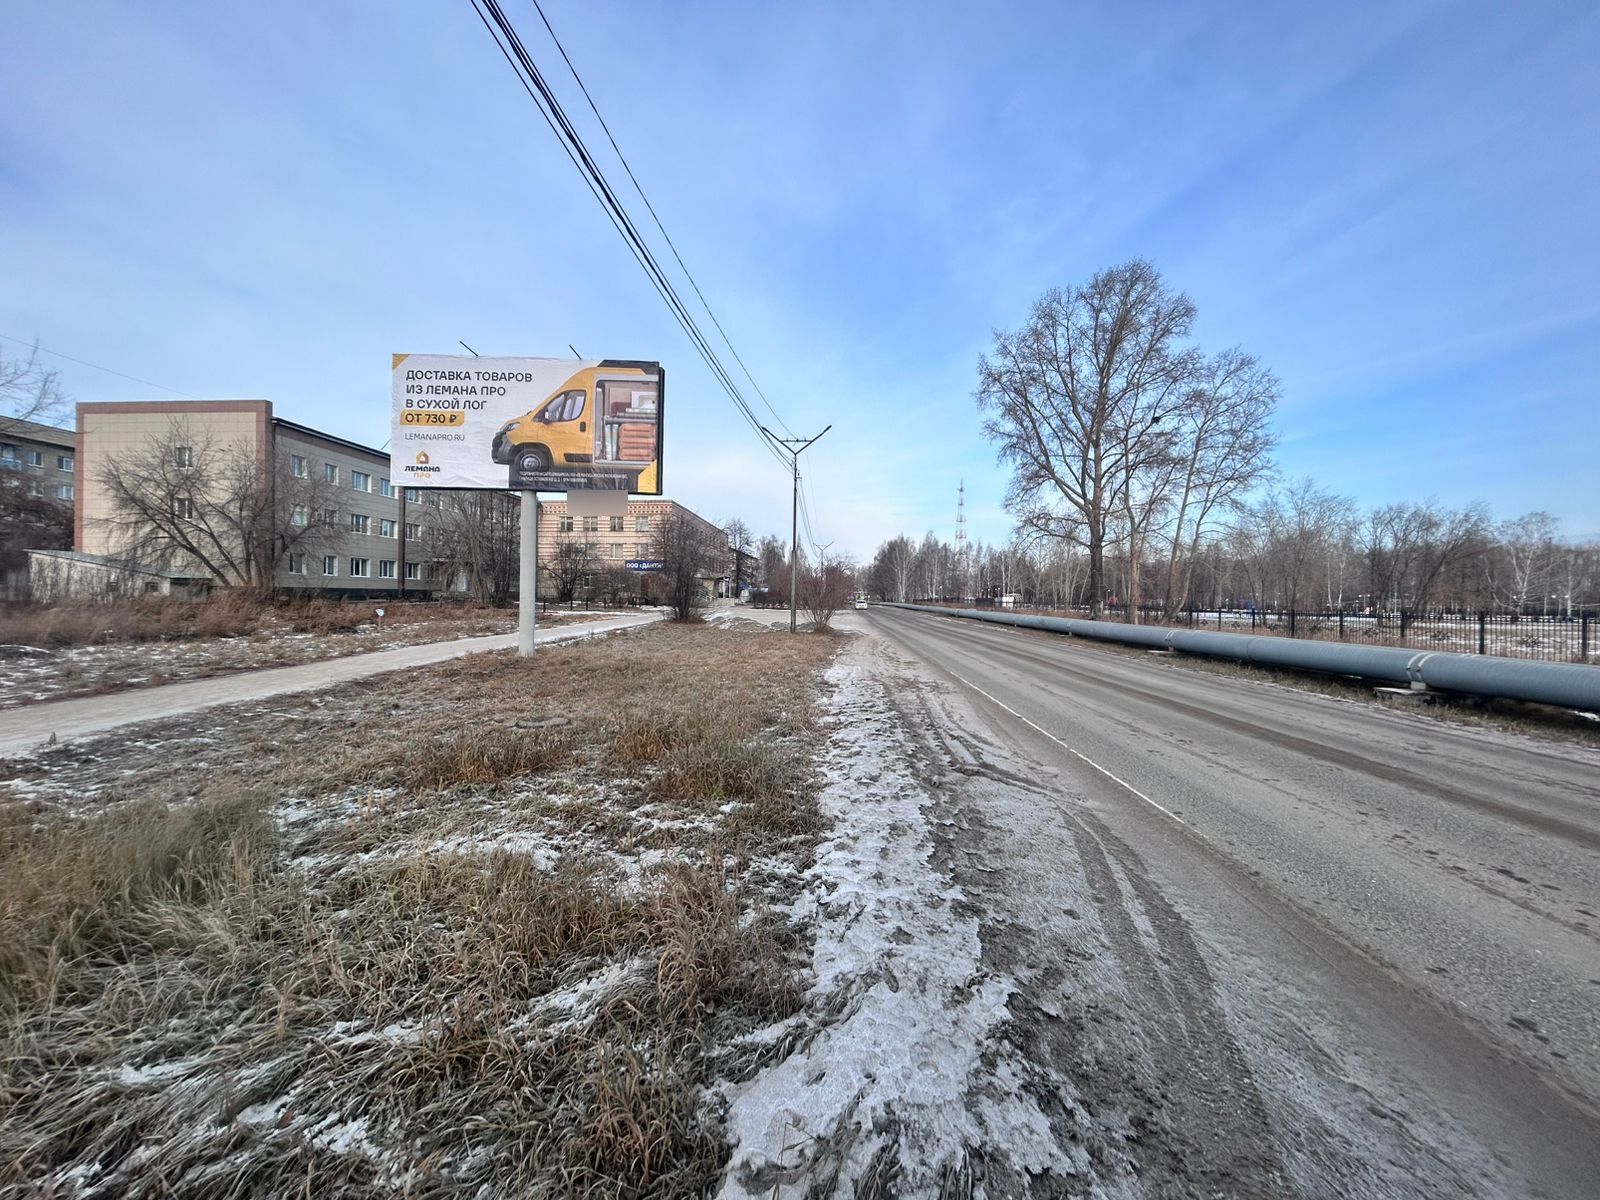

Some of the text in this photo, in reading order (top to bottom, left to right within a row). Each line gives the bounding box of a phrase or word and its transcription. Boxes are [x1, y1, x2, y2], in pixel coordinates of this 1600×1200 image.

[406, 370, 533, 382] ДОСТАВКА ТОВАРОВ
[406, 385, 506, 396] ИЗ ЛЕМАНА ПРО
[405, 398, 487, 410] В СУХОЙ ЛОГ
[405, 413, 422, 423] ОТ
[425, 414, 446, 423] 730
[405, 433, 465, 441] LEMANAPRO.RU
